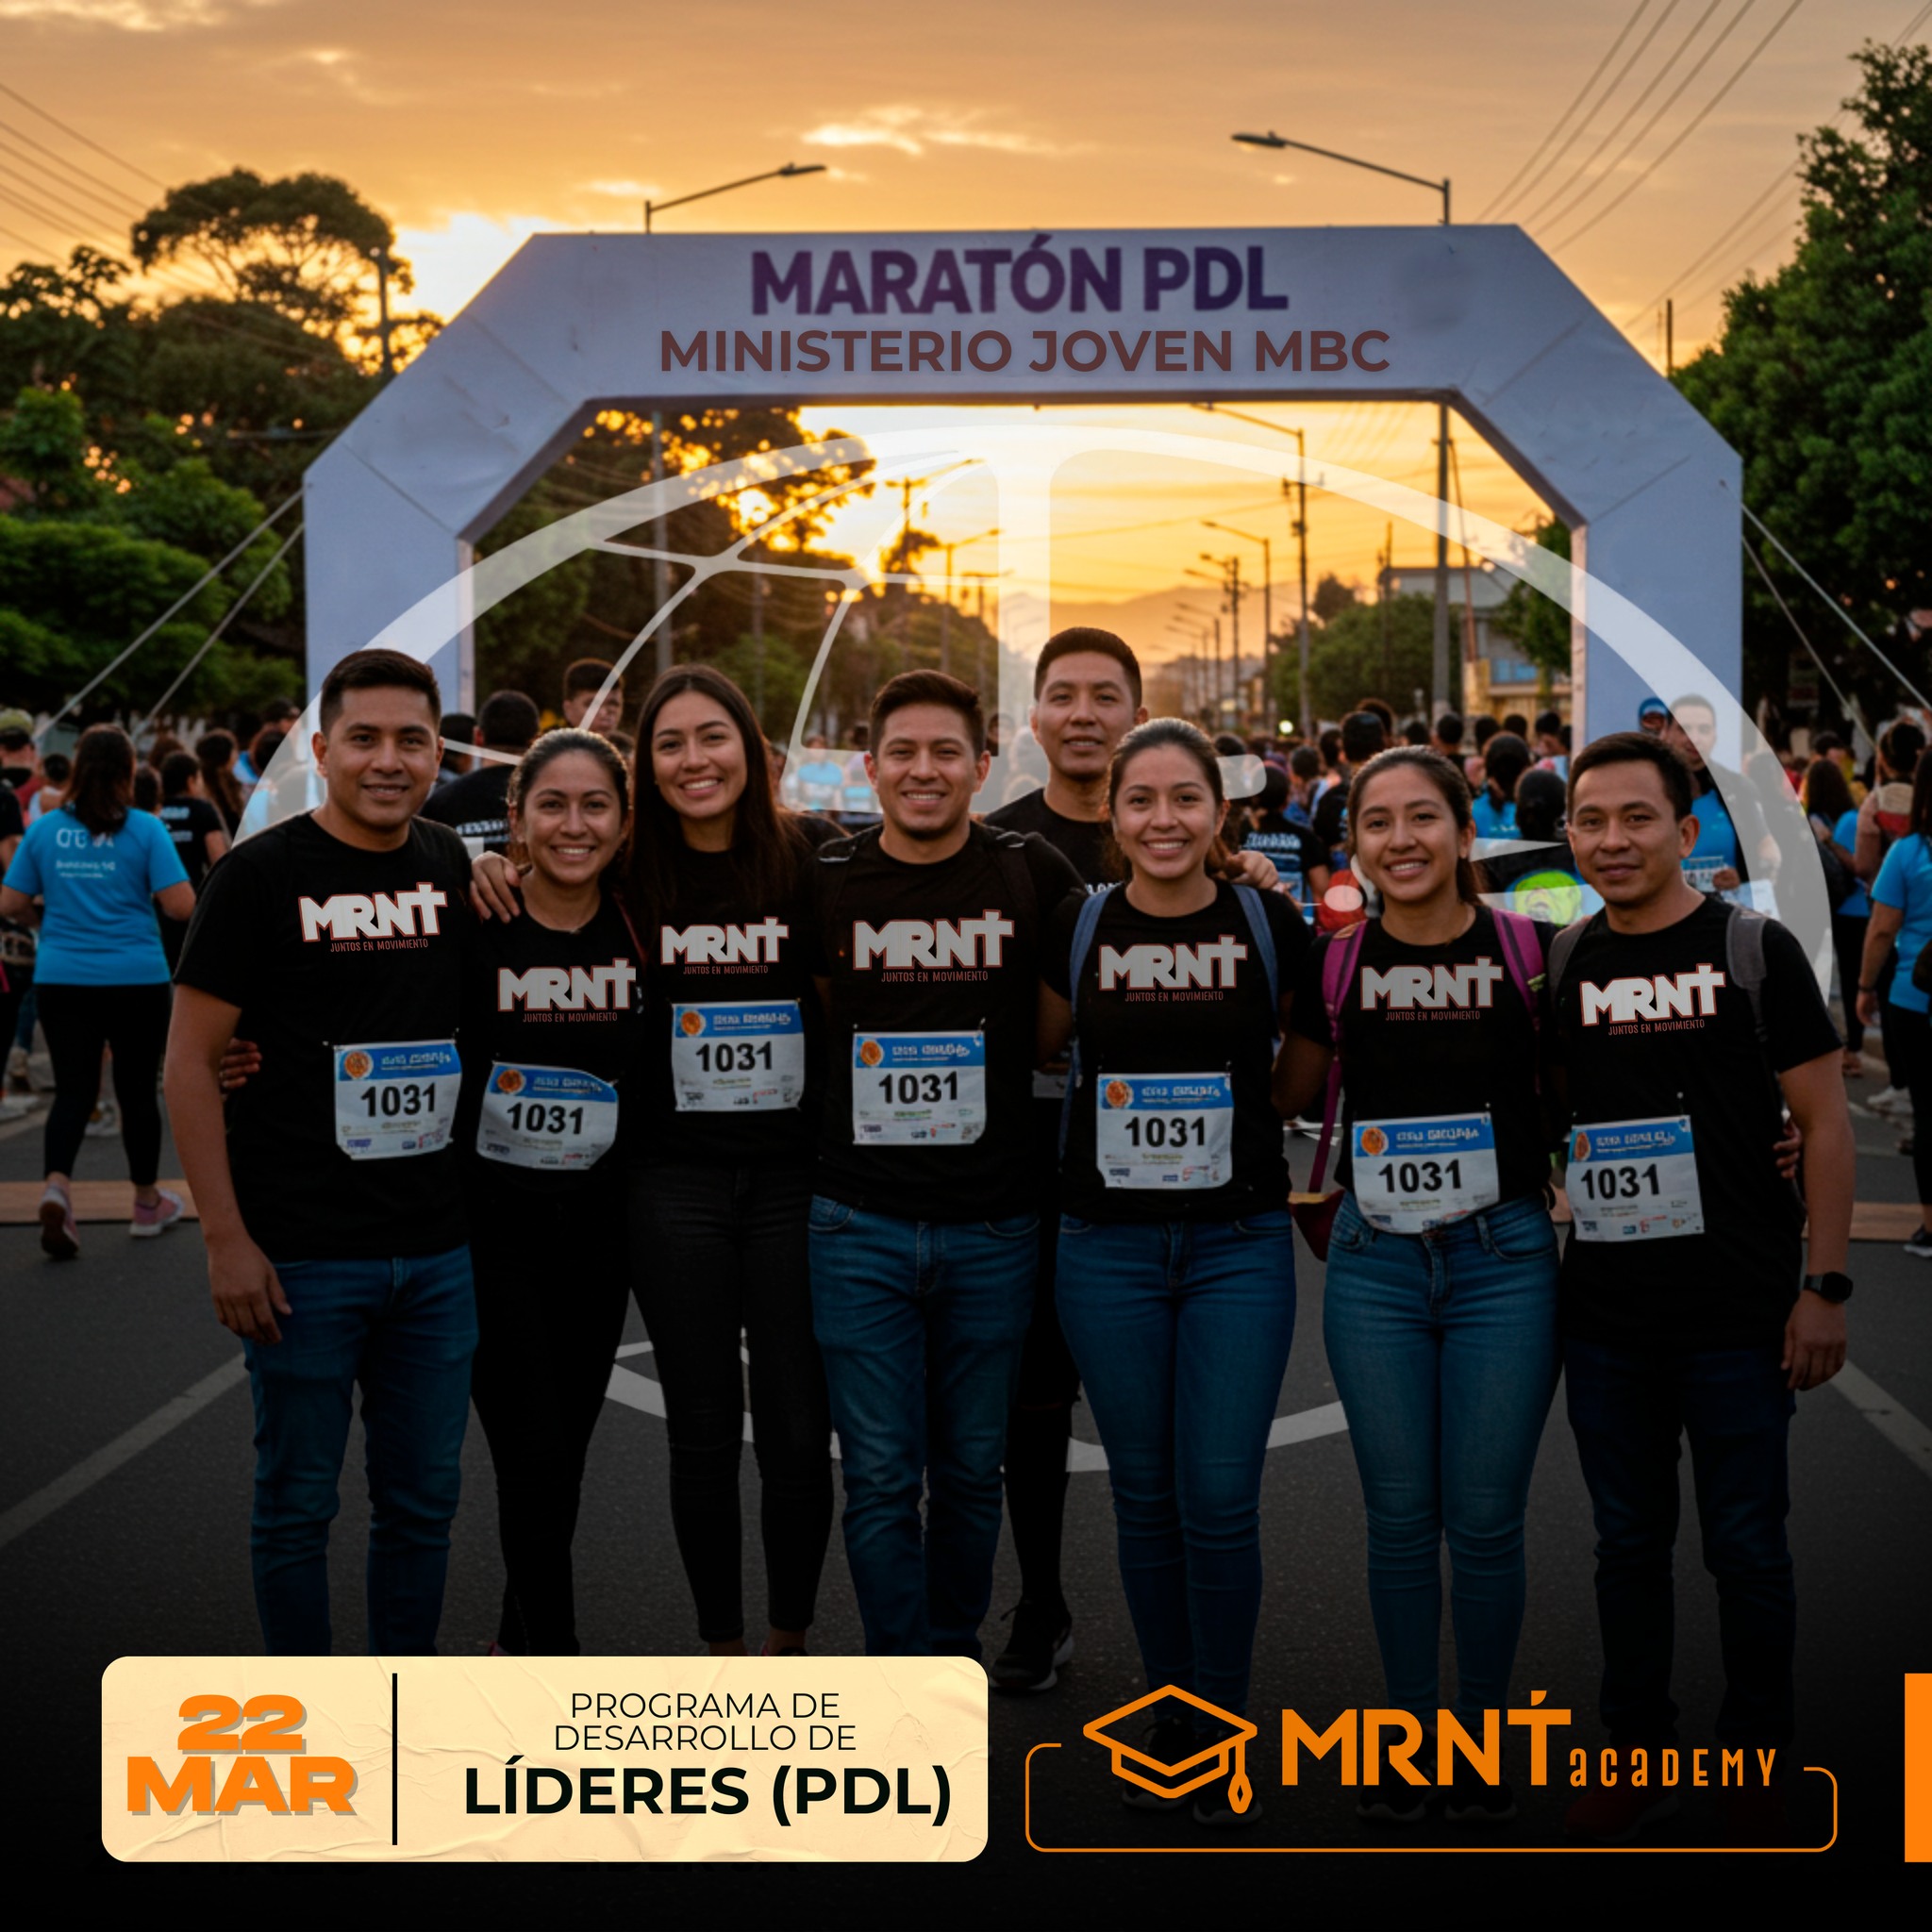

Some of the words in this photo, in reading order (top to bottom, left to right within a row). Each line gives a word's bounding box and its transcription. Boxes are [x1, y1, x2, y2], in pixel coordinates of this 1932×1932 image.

[751, 233, 1123, 315] MARATÓN
[1143, 245, 1290, 312] PDL
[661, 330, 1012, 373] MINISTERIO
[1030, 330, 1231, 373] JOVEN
[1256, 330, 1390, 373] MBC
[330, 942, 361, 953] JUNTOS
[363, 941, 375, 951] EN
[377, 938, 429, 950] MOVIMIENTO
[683, 966, 710, 974] JUNTOS
[711, 966, 721, 974] EN
[724, 965, 769, 974] MOVIMIENTO
[881, 972, 915, 982] JUNTOS
[917, 972, 929, 982] EN
[932, 971, 989, 982] MOVIMIENTO
[1124, 992, 1156, 1002] JUNTOS
[1158, 992, 1169, 1002] EN
[1172, 991, 1224, 1002] MOVIMIENTO
[523, 1013, 553, 1023] JUNTOS
[555, 1013, 565, 1023] EN
[568, 1012, 618, 1023] MOVIMIENTO
[1385, 1011, 1415, 1021] JUNTOS
[1417, 1011, 1427, 1021] EN
[1431, 1010, 1481, 1021] MOVIMIENTO
[1607, 1024, 1639, 1036] JUNTOS
[1641, 1024, 1652, 1033] EN
[1655, 1019, 1706, 1032] MOVIMIENTO
[695, 1041, 773, 1073] 1031
[360, 1082, 437, 1118] 1031
[878, 1070, 958, 1105] 1031
[507, 1101, 584, 1135] 1031
[1124, 1116, 1206, 1148] 1031
[1377, 1158, 1462, 1193] 1031
[1580, 1163, 1660, 1201] 1031
